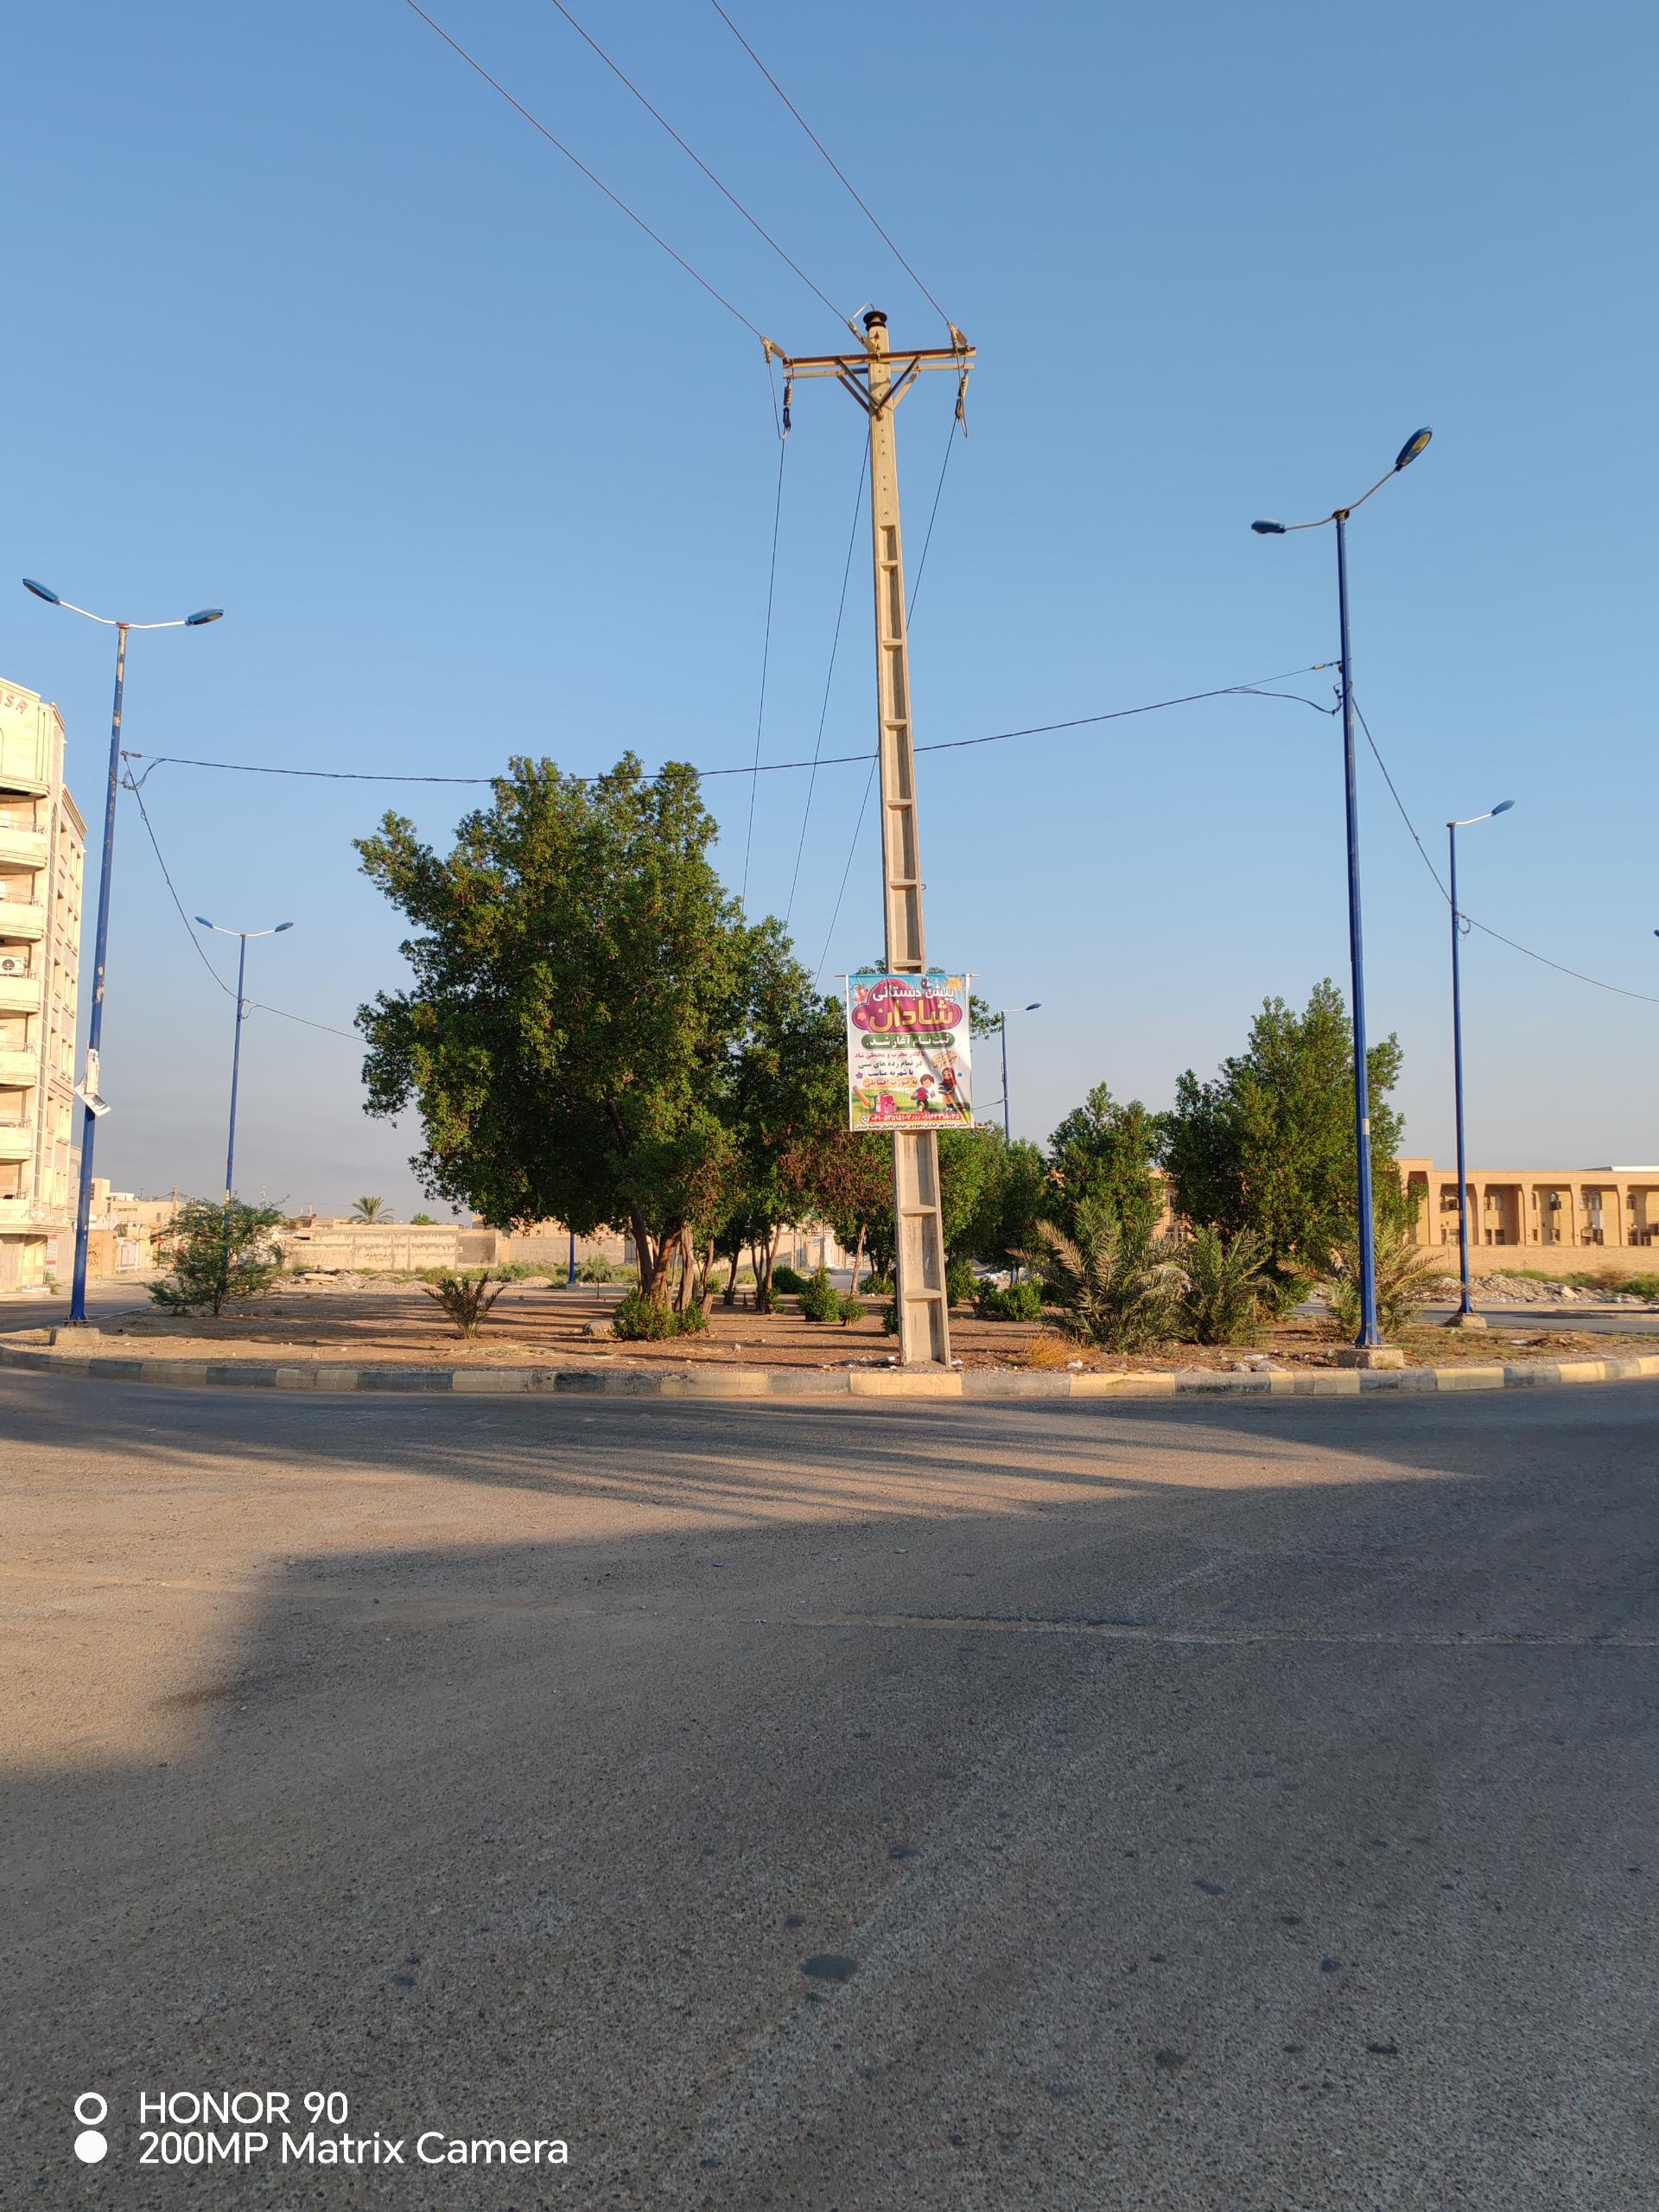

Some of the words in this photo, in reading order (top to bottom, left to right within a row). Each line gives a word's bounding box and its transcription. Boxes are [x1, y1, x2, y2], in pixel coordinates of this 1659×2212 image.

[873, 985, 922, 1001] دبستانی
[925, 984, 955, 1002] پیش
[869, 999, 954, 1033] شادان
[892, 1034, 912, 1048] آغاز
[912, 1035, 931, 1047] نام
